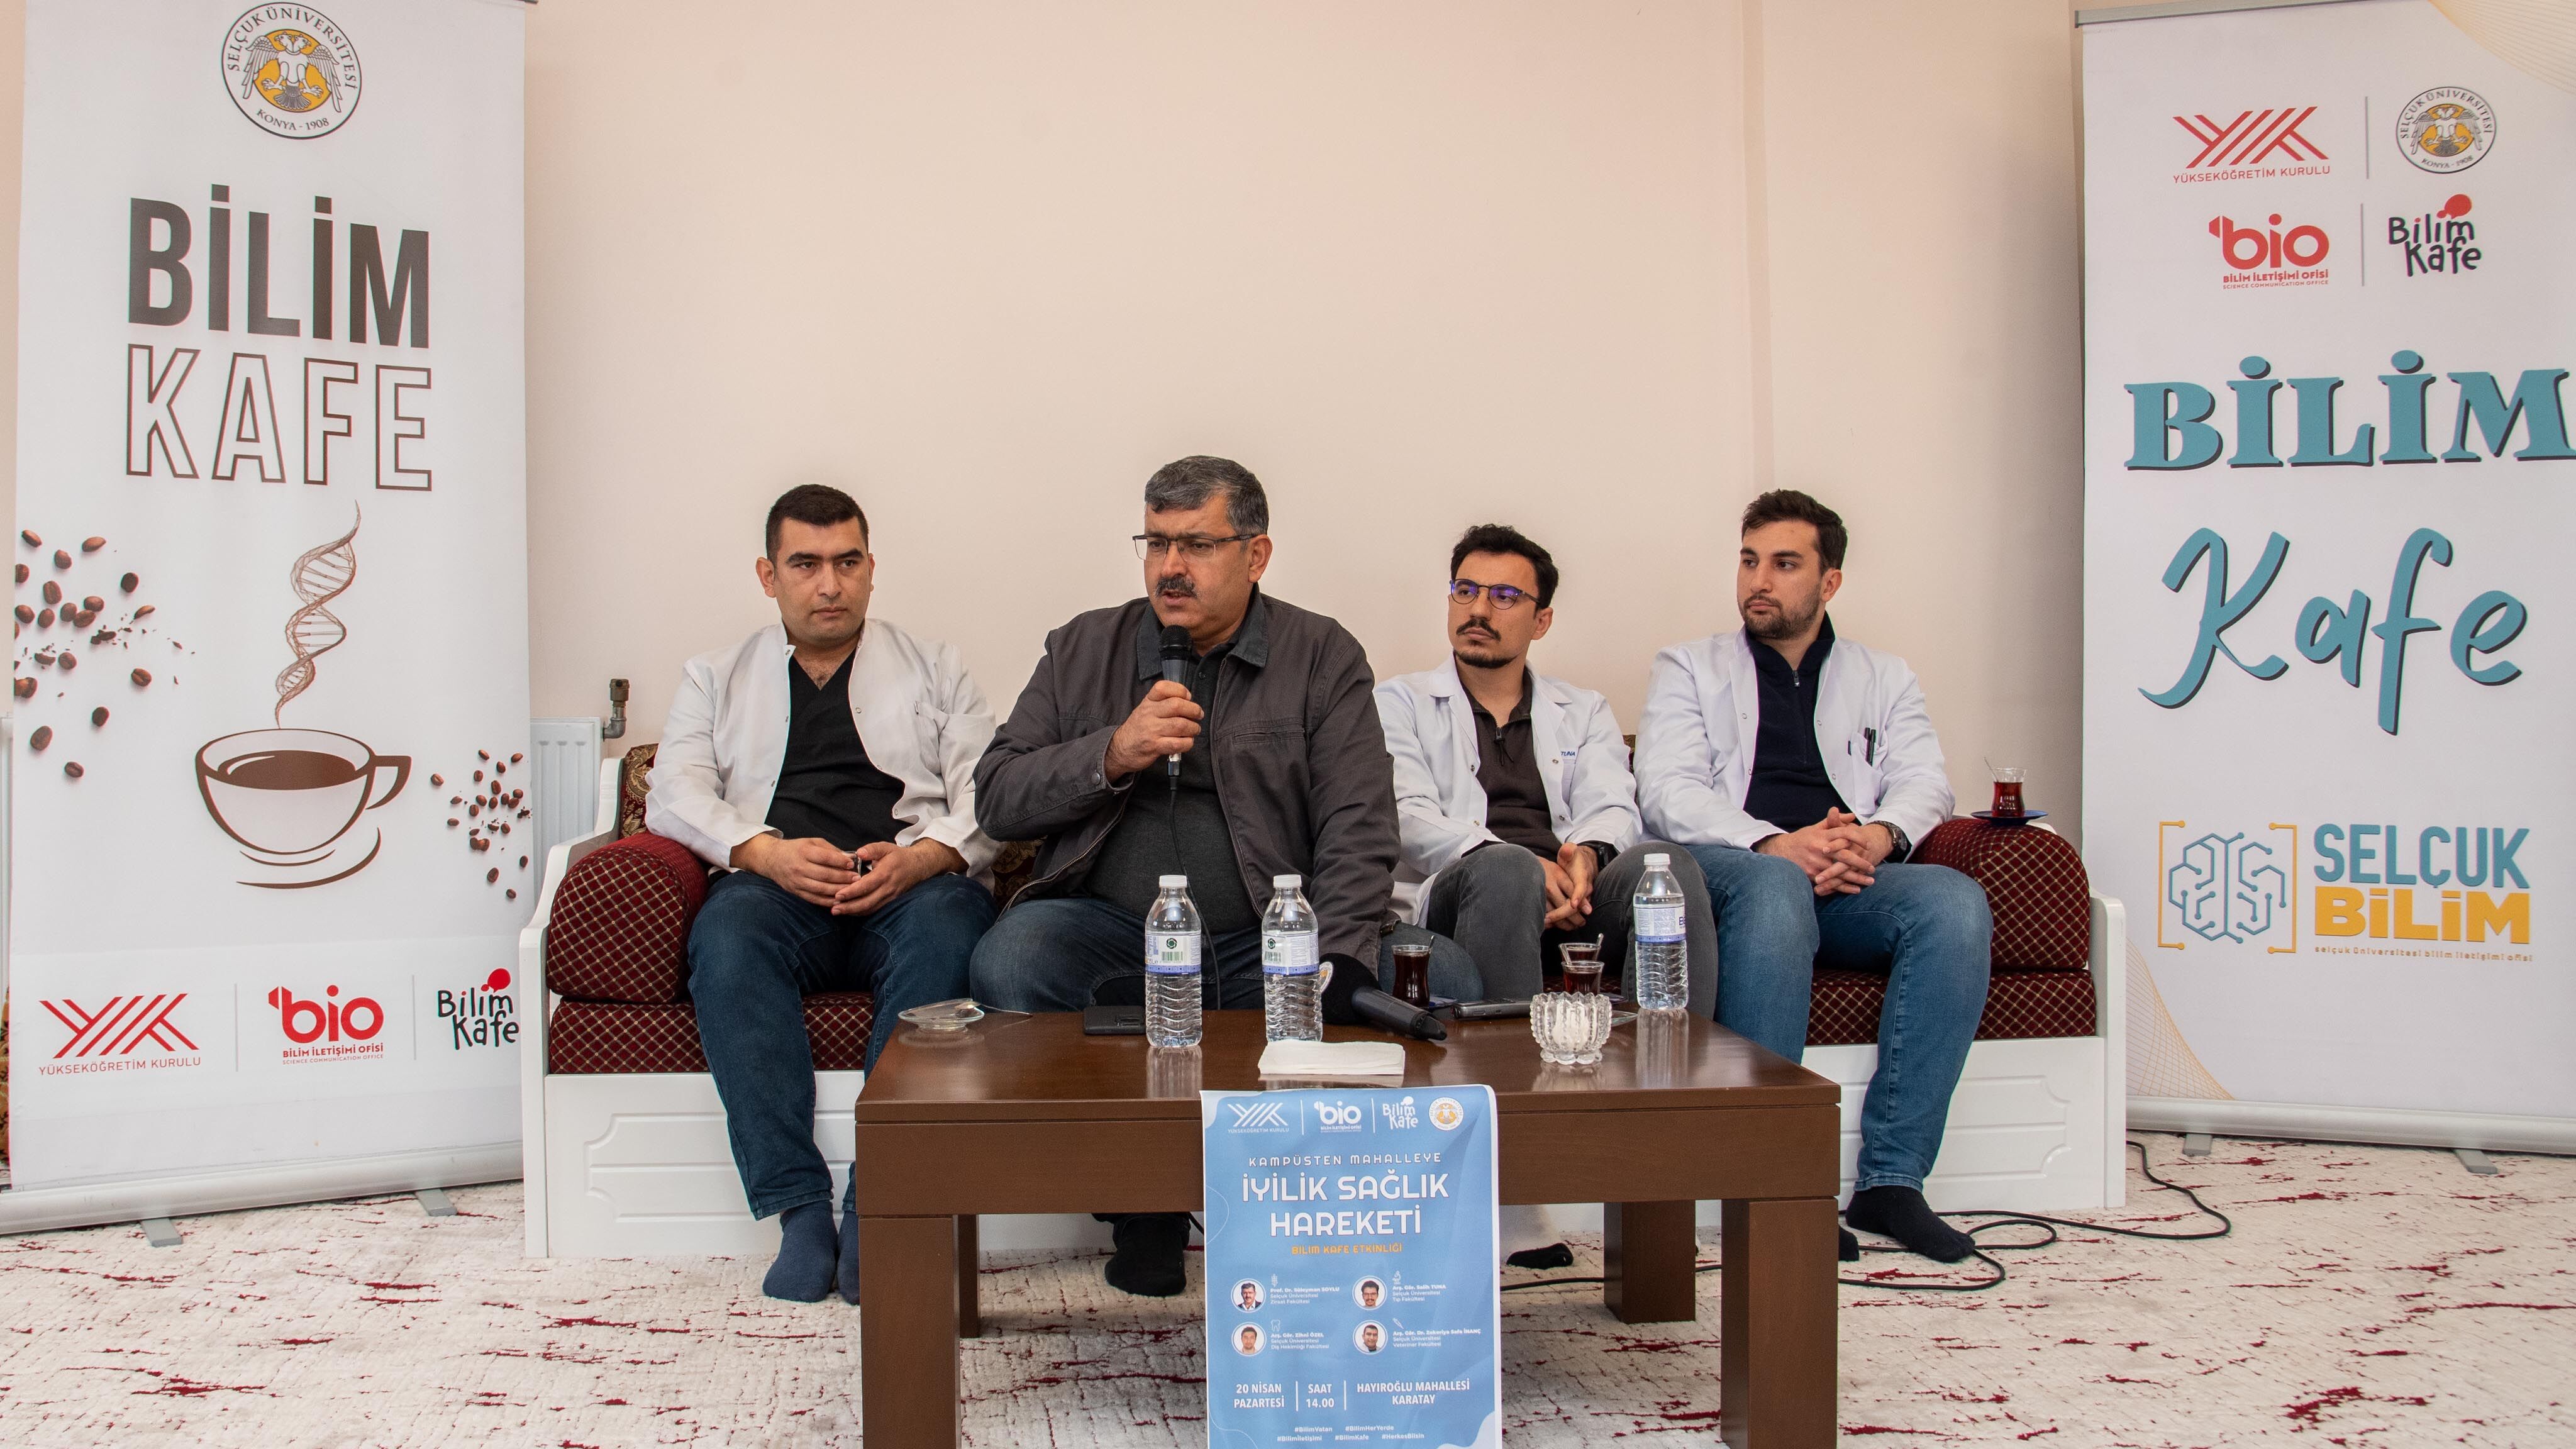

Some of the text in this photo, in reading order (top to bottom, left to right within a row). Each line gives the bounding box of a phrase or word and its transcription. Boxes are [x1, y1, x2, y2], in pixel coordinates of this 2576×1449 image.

[228, 6, 358, 89] SELÇUK ÜNİVERSİTESİ
[257, 109, 296, 131] KONYA
[306, 118, 330, 130] 1908
[2400, 89, 2492, 139] SELÇUK ÜNİVERSİTESİ
[2421, 158, 2450, 169] KONYA
[2456, 155, 2473, 166] 1908
[2173, 165, 2331, 184] YÜKSEKÖĞRETİM KURULU
[2388, 213, 2475, 245] Bilim
[2209, 213, 2329, 270] bio
[128, 182, 430, 350] BİLİM
[2404, 236, 2482, 277] Kafe
[2223, 269, 2328, 283] BİLİM İLETİŞİMİ OFİSİ
[126, 343, 433, 492] KAFE
[2123, 350, 2576, 470] BİLİM
[2138, 528, 2527, 736] Kafe
[2314, 823, 2530, 889] SELÇUK
[2314, 886, 2530, 945] BİLİM
[2314, 945, 2350, 955] selçuk
[2353, 946, 2421, 957] üniversitesi
[2424, 950, 2452, 958] bilim
[438, 987, 513, 1018] Bilim
[269, 985, 384, 1043] bio
[453, 1009, 519, 1050] Kafe
[283, 1043, 384, 1058] BİLİM İLETİŞİMİ OFİSİ
[38, 1057, 201, 1075] YÜKSEKÖĞRETİM KURULU
[1314, 1101, 1362, 1125] bio
[1382, 1102, 1416, 1116] Bilim
[1389, 1113, 1418, 1130] Kafe
[1249, 1152, 1441, 1167] KAMPÜSTEN MAHALLEYE
[1242, 1169, 1450, 1202] İYİLİK SAĞLIK
[1270, 1204, 1421, 1237] HAREKETİ
[1323, 1245, 1350, 1254] KAFE
[1353, 1242, 1402, 1253] ETKİNLİĞİ
[1236, 1380, 1282, 1394] 20 NİSAN
[1307, 1384, 1333, 1394] SAAT
[1357, 1377, 1470, 1394] HAYIROĞLU MAHALLESİ
[1233, 1395, 1285, 1409] PAZARTESİ
[1306, 1397, 1335, 1408] 14.00
[1392, 1394, 1436, 1405] KARATAY
[1382, 1432, 1424, 1440] #HerkesBilsin
